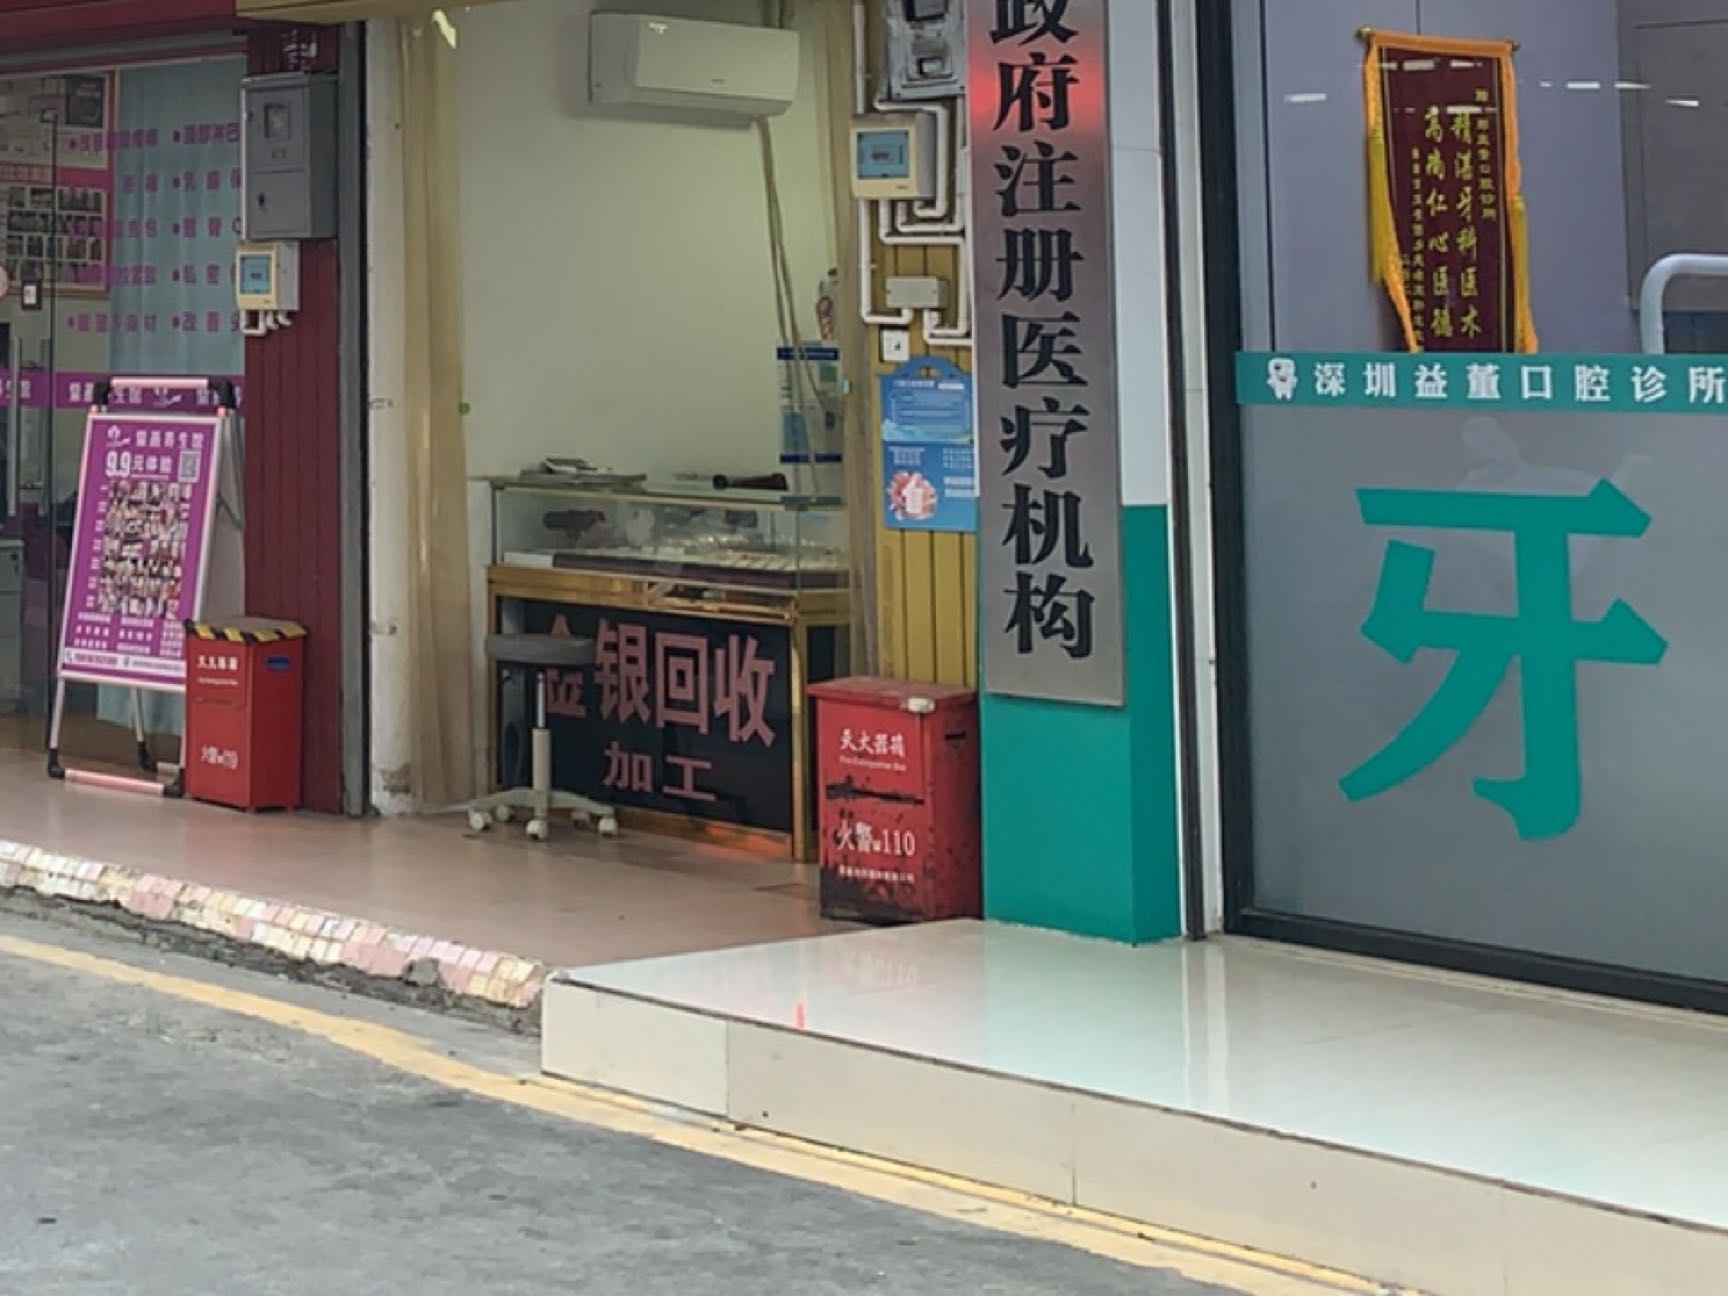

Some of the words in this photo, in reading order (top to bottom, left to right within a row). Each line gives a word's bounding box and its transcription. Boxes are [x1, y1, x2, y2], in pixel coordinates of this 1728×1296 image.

[1313, 362, 1726, 404] 深圳益董口腔诊所
[1338, 476, 1669, 841] 牙
[603, 741, 717, 803] 加工
